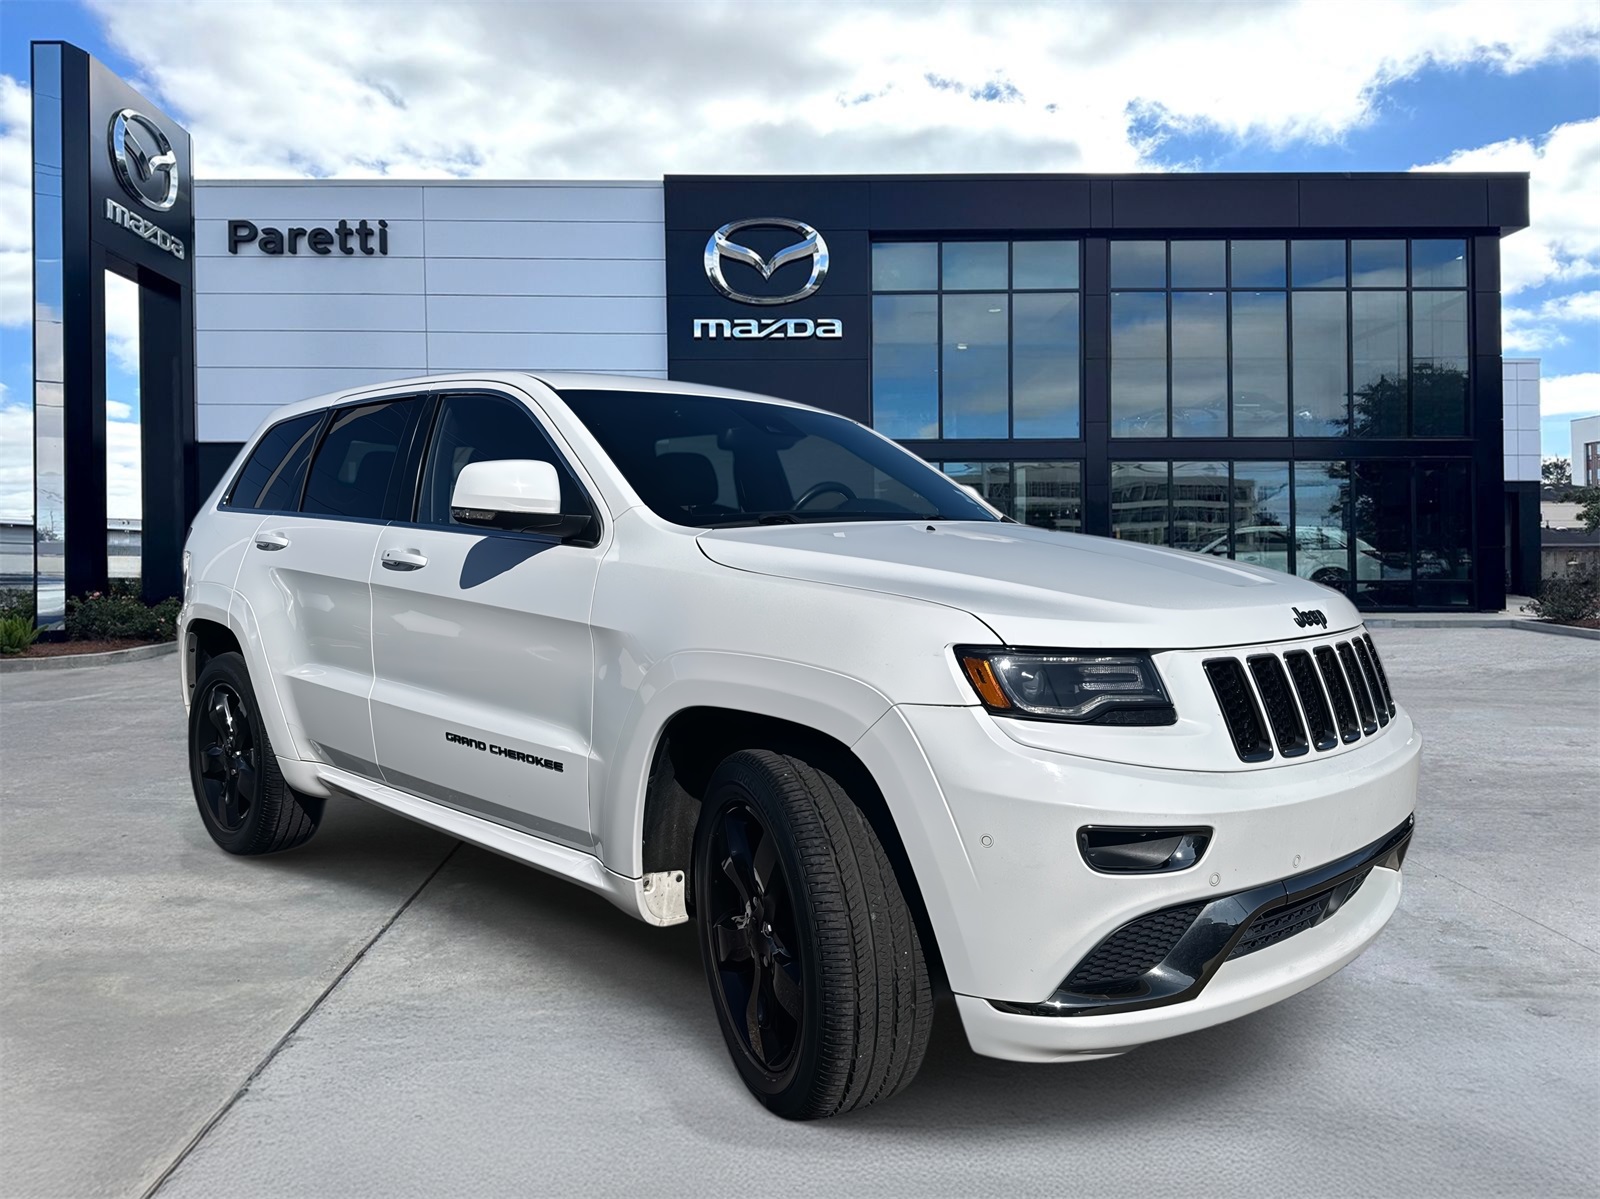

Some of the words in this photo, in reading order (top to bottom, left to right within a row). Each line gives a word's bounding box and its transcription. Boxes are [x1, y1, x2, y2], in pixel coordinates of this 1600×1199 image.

[227, 219, 389, 255] Paretti
[1291, 606, 1328, 630] Jeep
[445, 731, 487, 751] GRAND
[489, 744, 564, 773] CHEROKEE
